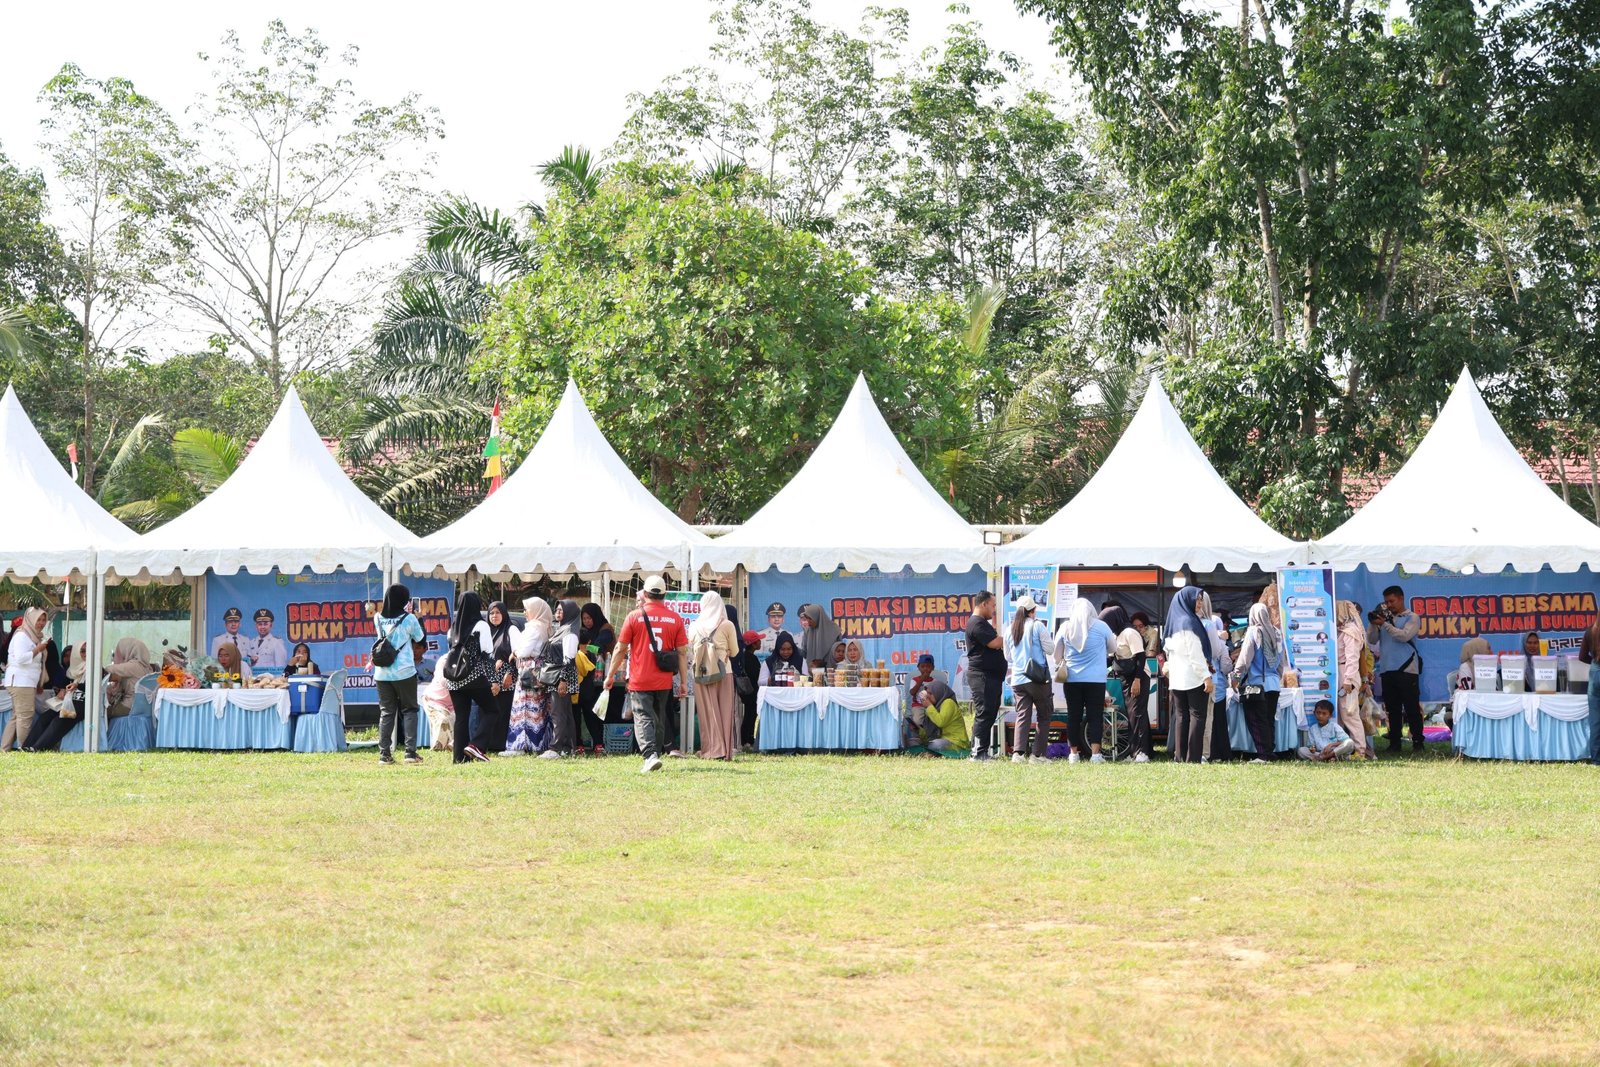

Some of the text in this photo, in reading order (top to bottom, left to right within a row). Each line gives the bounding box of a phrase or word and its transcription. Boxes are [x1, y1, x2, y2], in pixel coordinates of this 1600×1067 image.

[288, 602, 361, 622] BERAKSI
[833, 596, 976, 617] BERAKSI BERSA
[1412, 594, 1596, 616] BERAKSI BERSAMA
[289, 623, 344, 641] UMKM
[893, 616, 946, 631] TANAH
[1478, 614, 1536, 631] TANAH
[649, 627, 663, 653] 5
